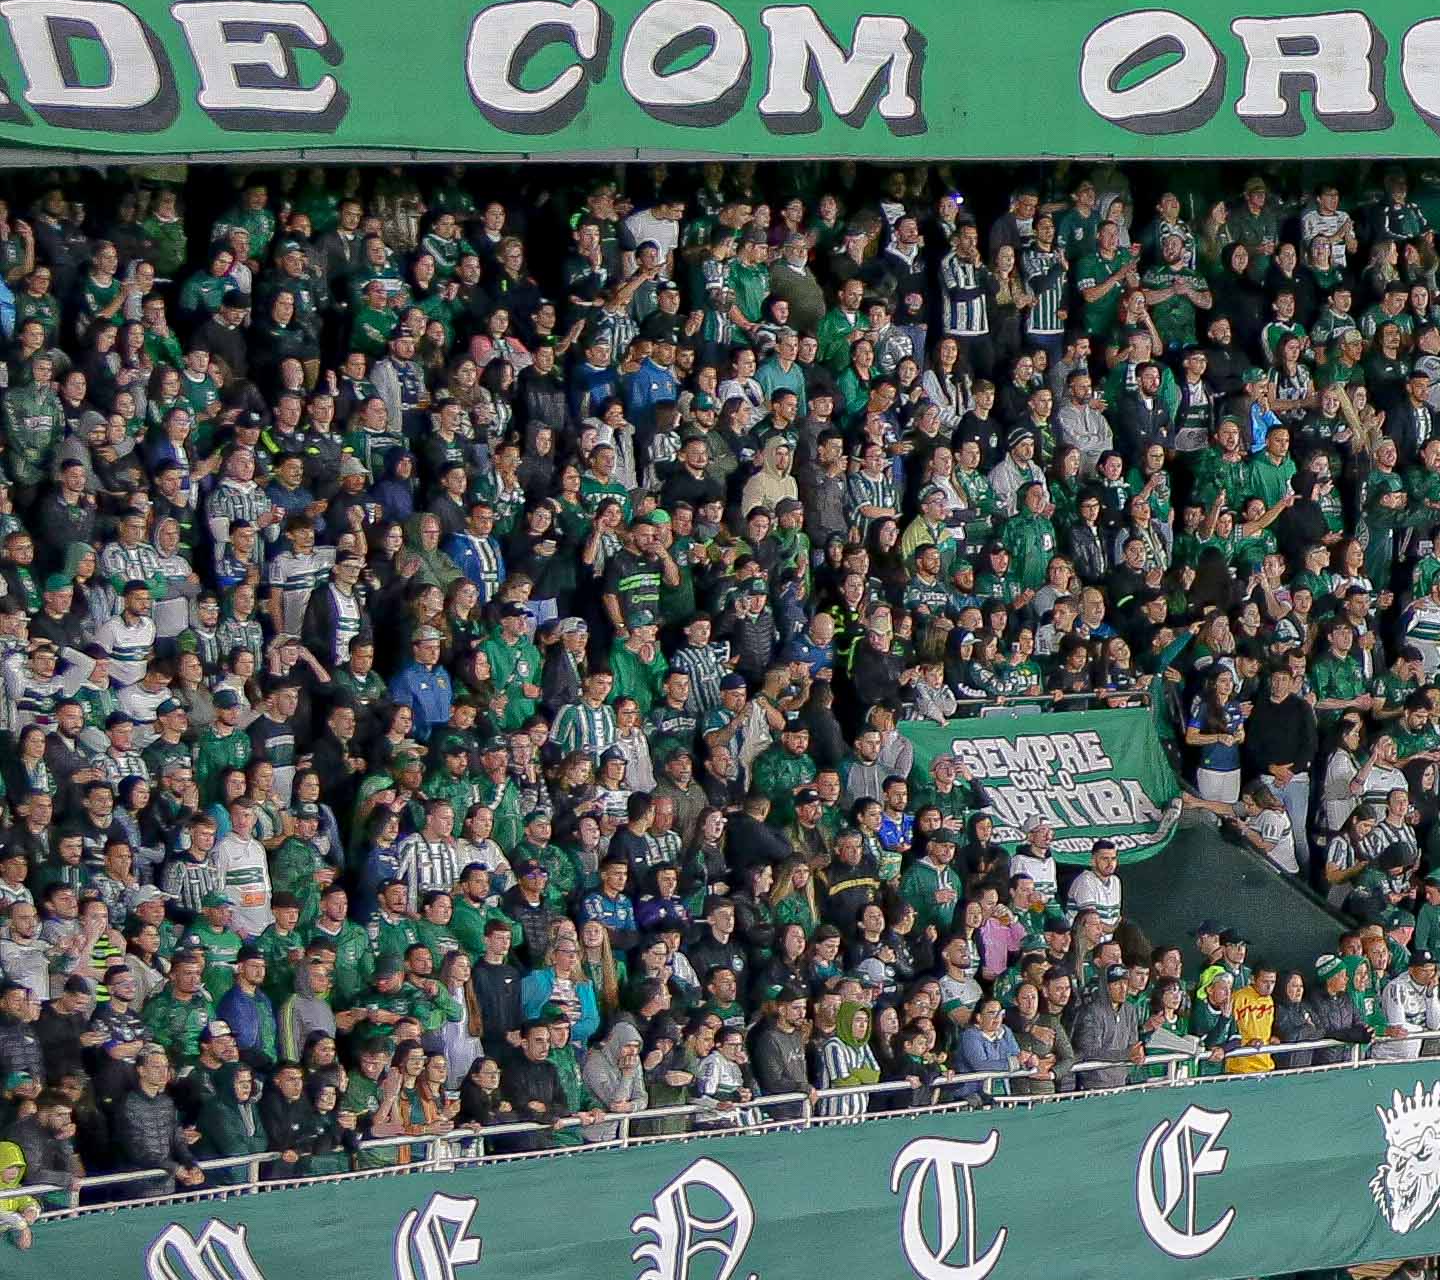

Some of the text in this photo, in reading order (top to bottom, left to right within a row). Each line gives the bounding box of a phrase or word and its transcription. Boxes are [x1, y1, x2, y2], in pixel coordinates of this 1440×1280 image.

[952, 730, 1113, 780] SEMPRE
[1008, 768, 1074, 792] COM O
